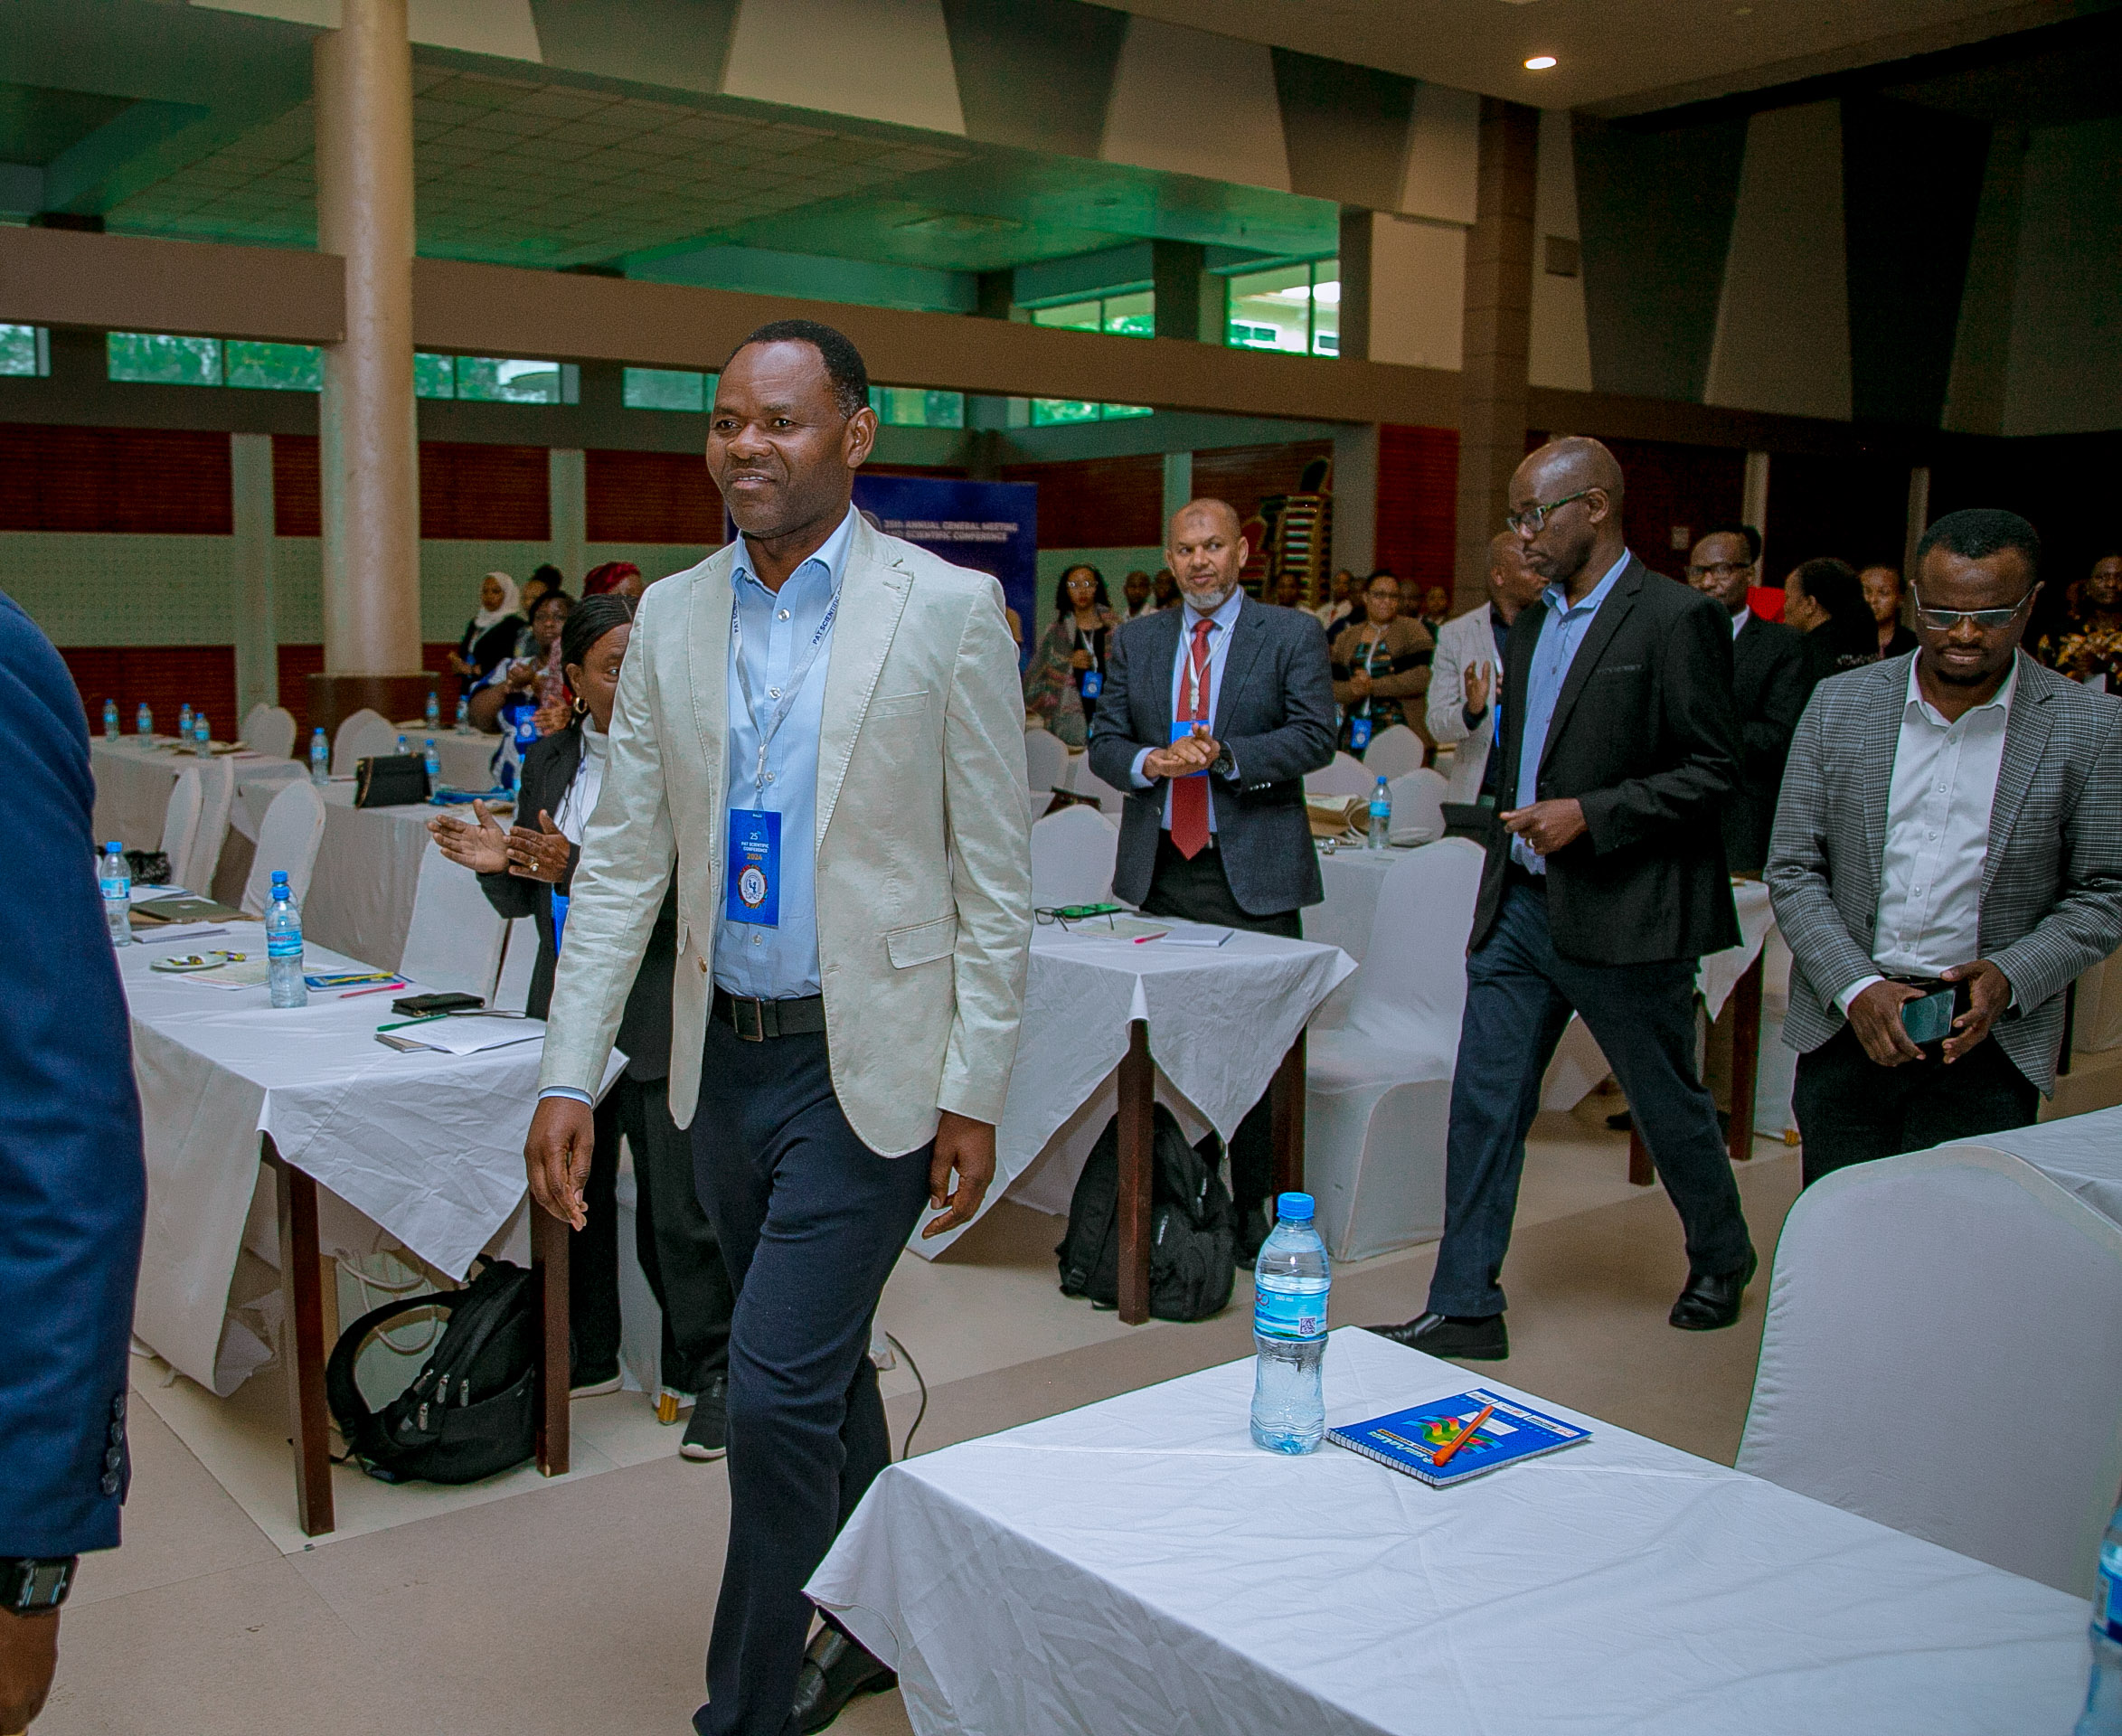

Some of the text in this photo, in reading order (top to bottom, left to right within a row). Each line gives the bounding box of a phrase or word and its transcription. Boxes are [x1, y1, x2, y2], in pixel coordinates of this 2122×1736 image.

[906, 521, 939, 530] ANNUAL
[942, 521, 981, 531] GENERAL
[982, 522, 1018, 532] MEETING
[905, 530, 951, 540] SCIENTIFIC
[953, 531, 1008, 542] CONFERENCE
[813, 596, 839, 645] PAT SCIENTIFIC
